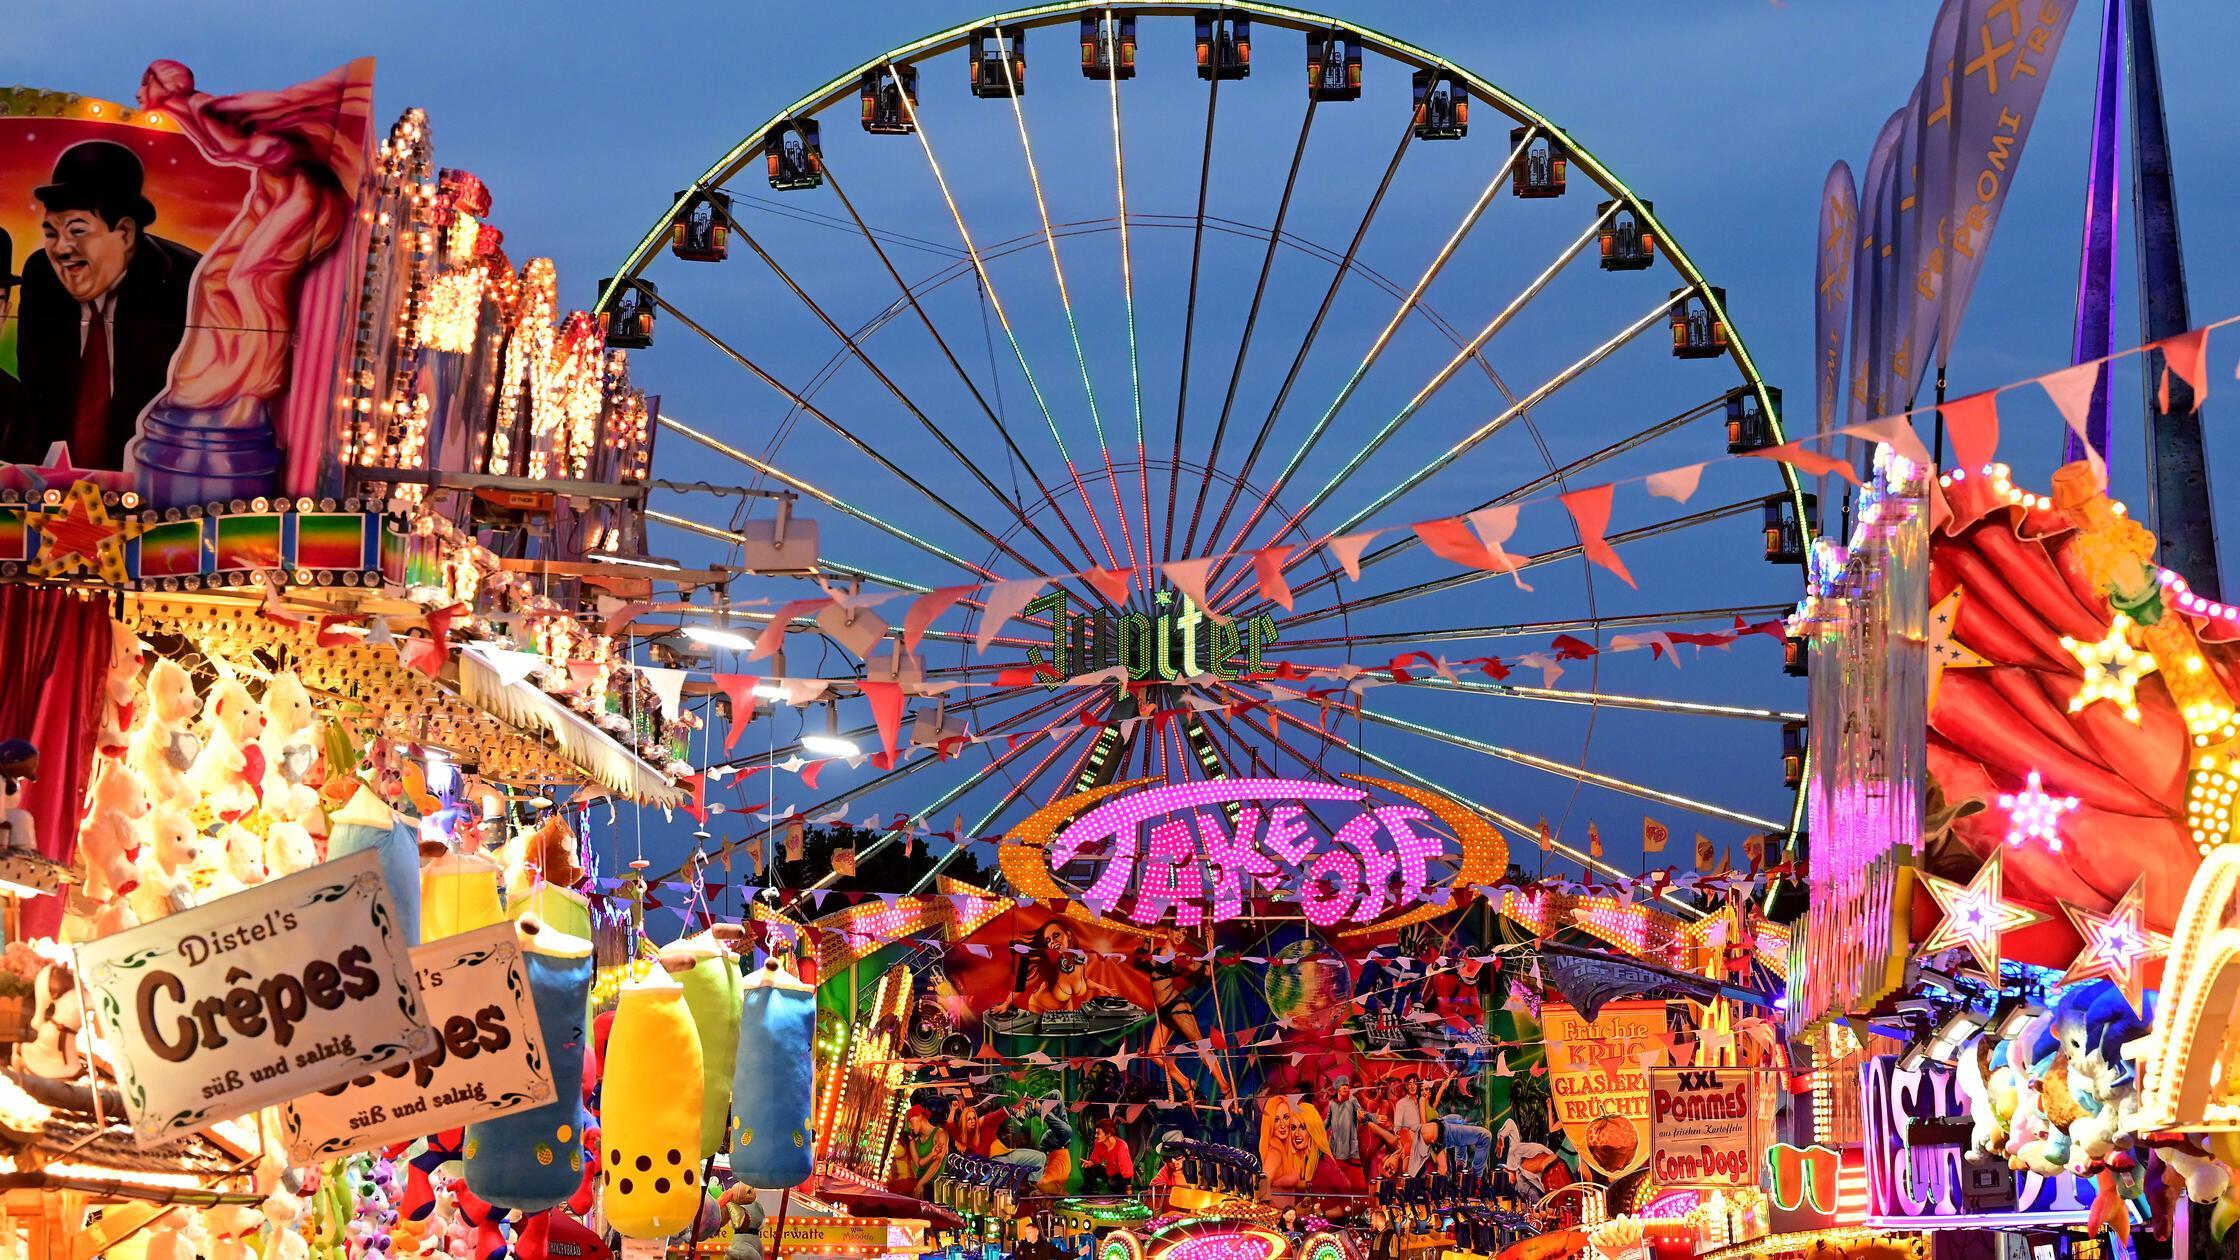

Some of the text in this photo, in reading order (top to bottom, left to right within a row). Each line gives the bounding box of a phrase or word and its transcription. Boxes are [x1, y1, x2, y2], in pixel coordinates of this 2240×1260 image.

[1952, 104, 2021, 260] PROMI
[1024, 589, 1279, 700] Jupiter
[1050, 778, 1443, 927] TAKE OFF
[177, 909, 298, 967] Distel's
[136, 945, 380, 1062] Crêpes
[1562, 1017, 1649, 1041] Früchte
[202, 1034, 357, 1099] süß und salzig
[1677, 1070, 1723, 1092] XXL
[350, 1082, 488, 1130] süß und salzig
[1655, 1144, 1748, 1183] Corn-Dogs
